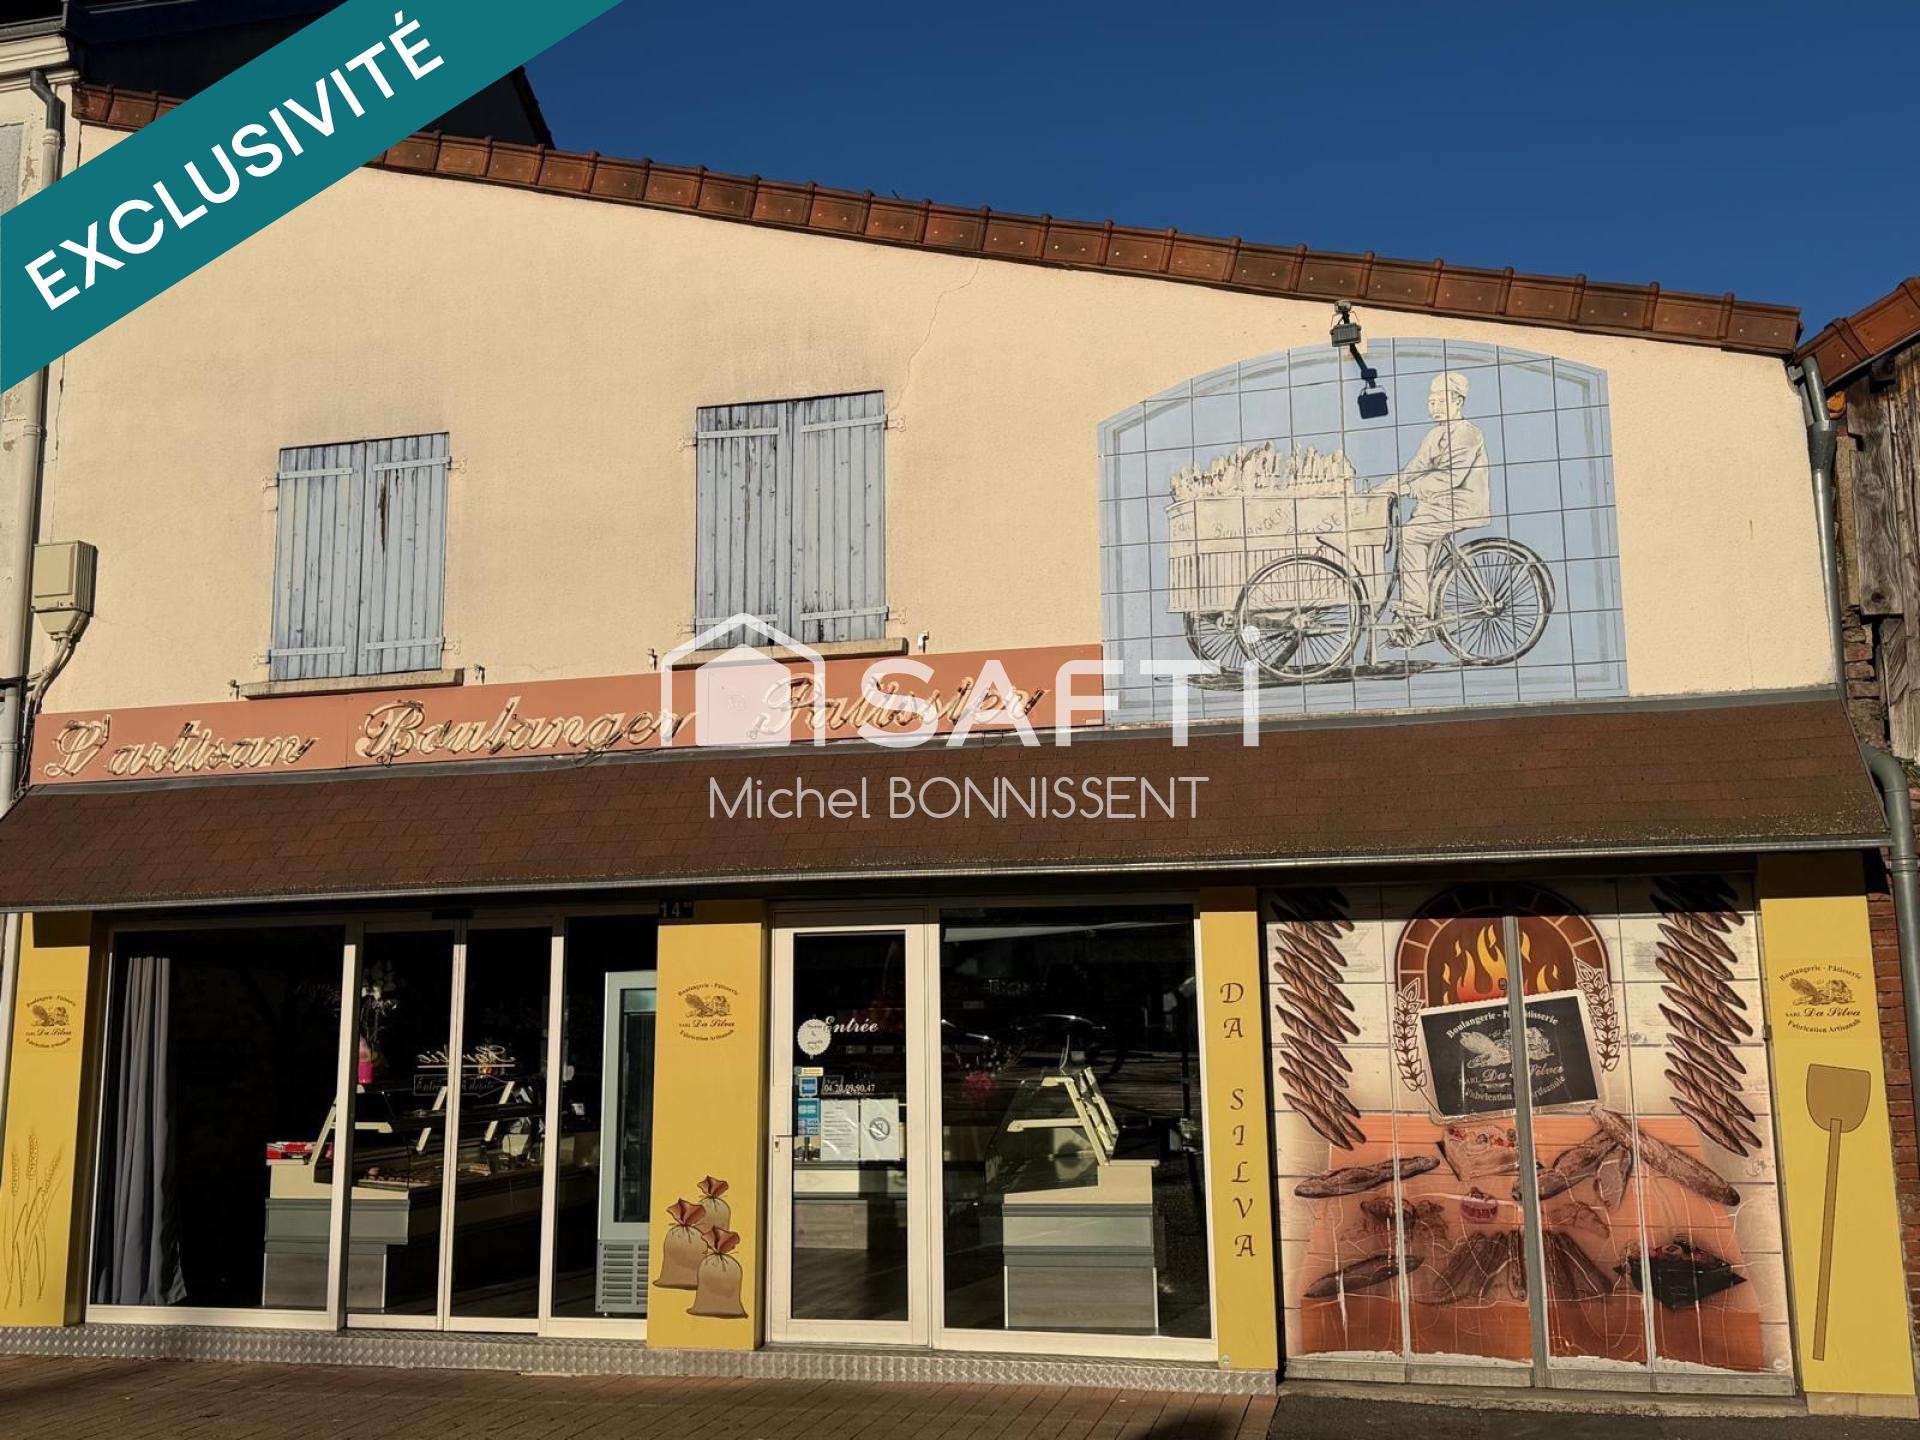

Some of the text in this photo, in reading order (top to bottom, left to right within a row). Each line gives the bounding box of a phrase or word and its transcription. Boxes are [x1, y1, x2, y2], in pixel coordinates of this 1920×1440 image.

[354, 696, 697, 766] Boulanger
[1803, 1007, 1824, 1017] Da
[1827, 1007, 1861, 1017] Silva
[823, 1015, 880, 1033] Entrée
[1446, 1012, 1496, 1039] Boulangerie
[1481, 1068, 1508, 1081] Da
